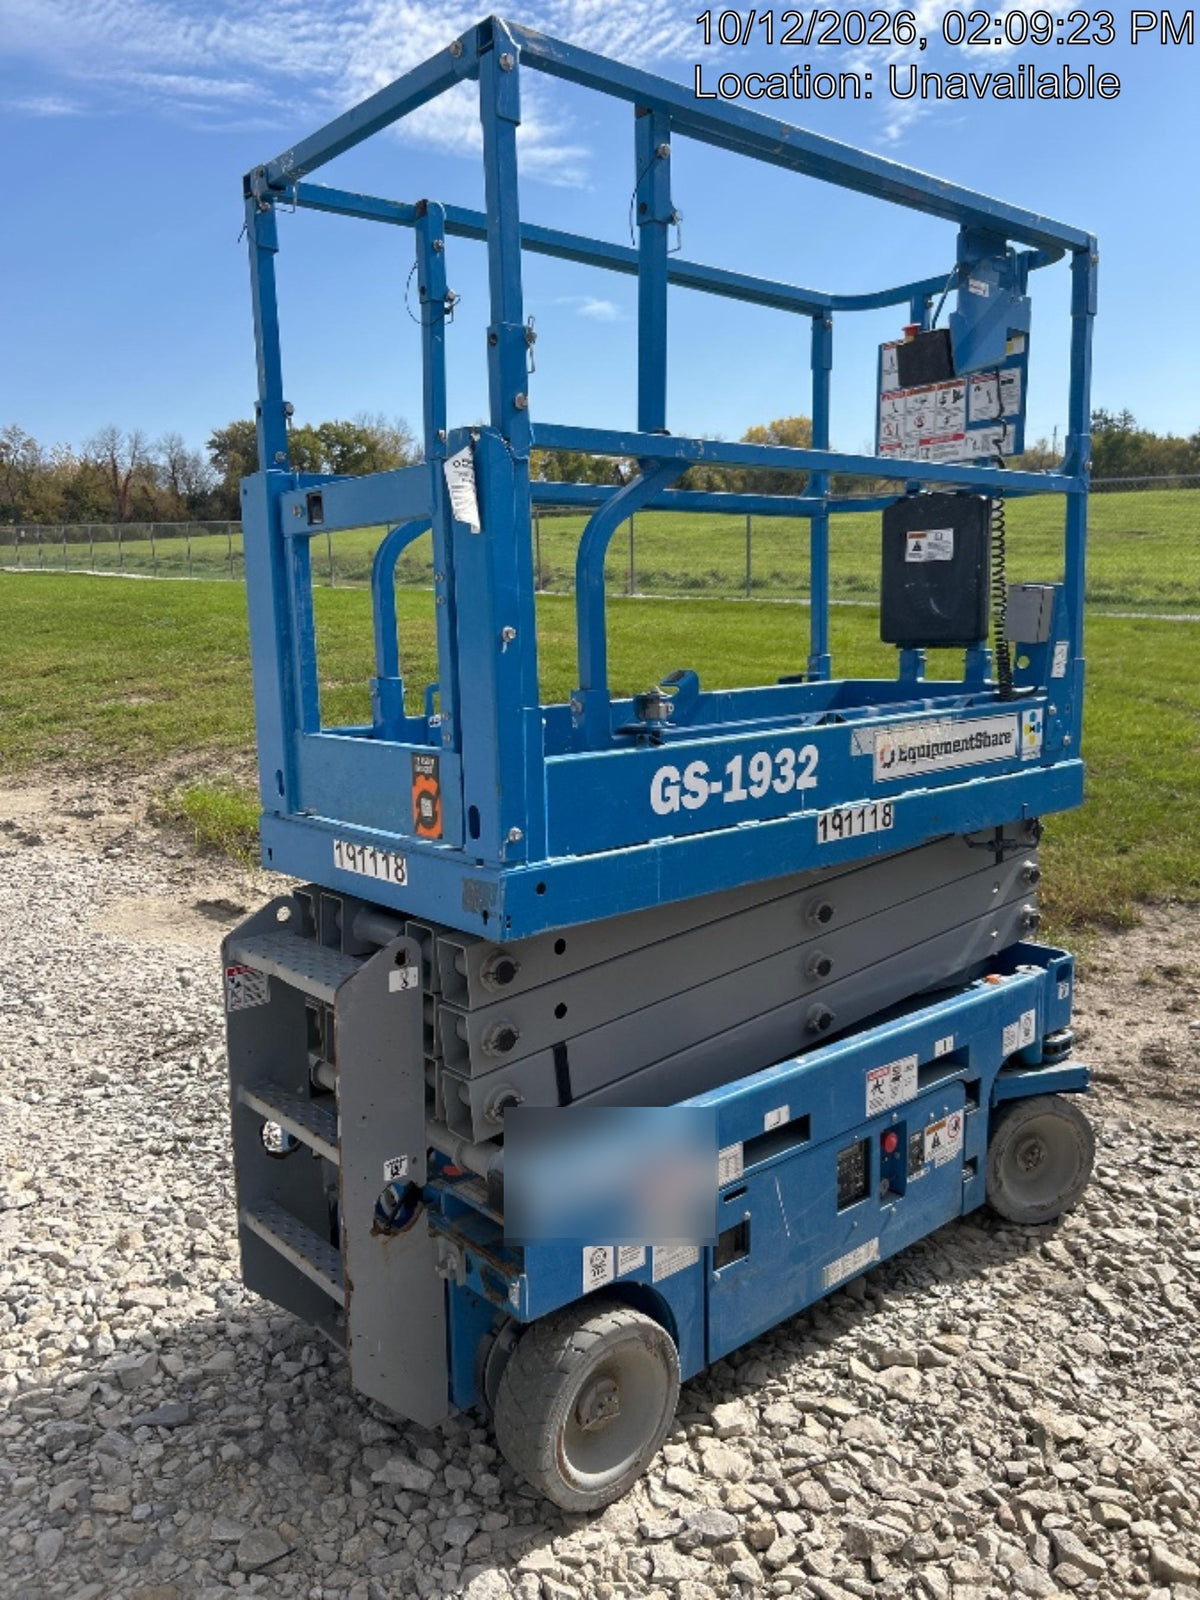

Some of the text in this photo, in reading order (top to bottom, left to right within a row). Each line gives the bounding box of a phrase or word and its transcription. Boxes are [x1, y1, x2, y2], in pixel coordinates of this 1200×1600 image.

[898, 731, 1012, 764] EquipmentShare
[650, 744, 819, 815] GS-1932
[818, 803, 892, 841] 191118
[335, 840, 406, 882] 191118
